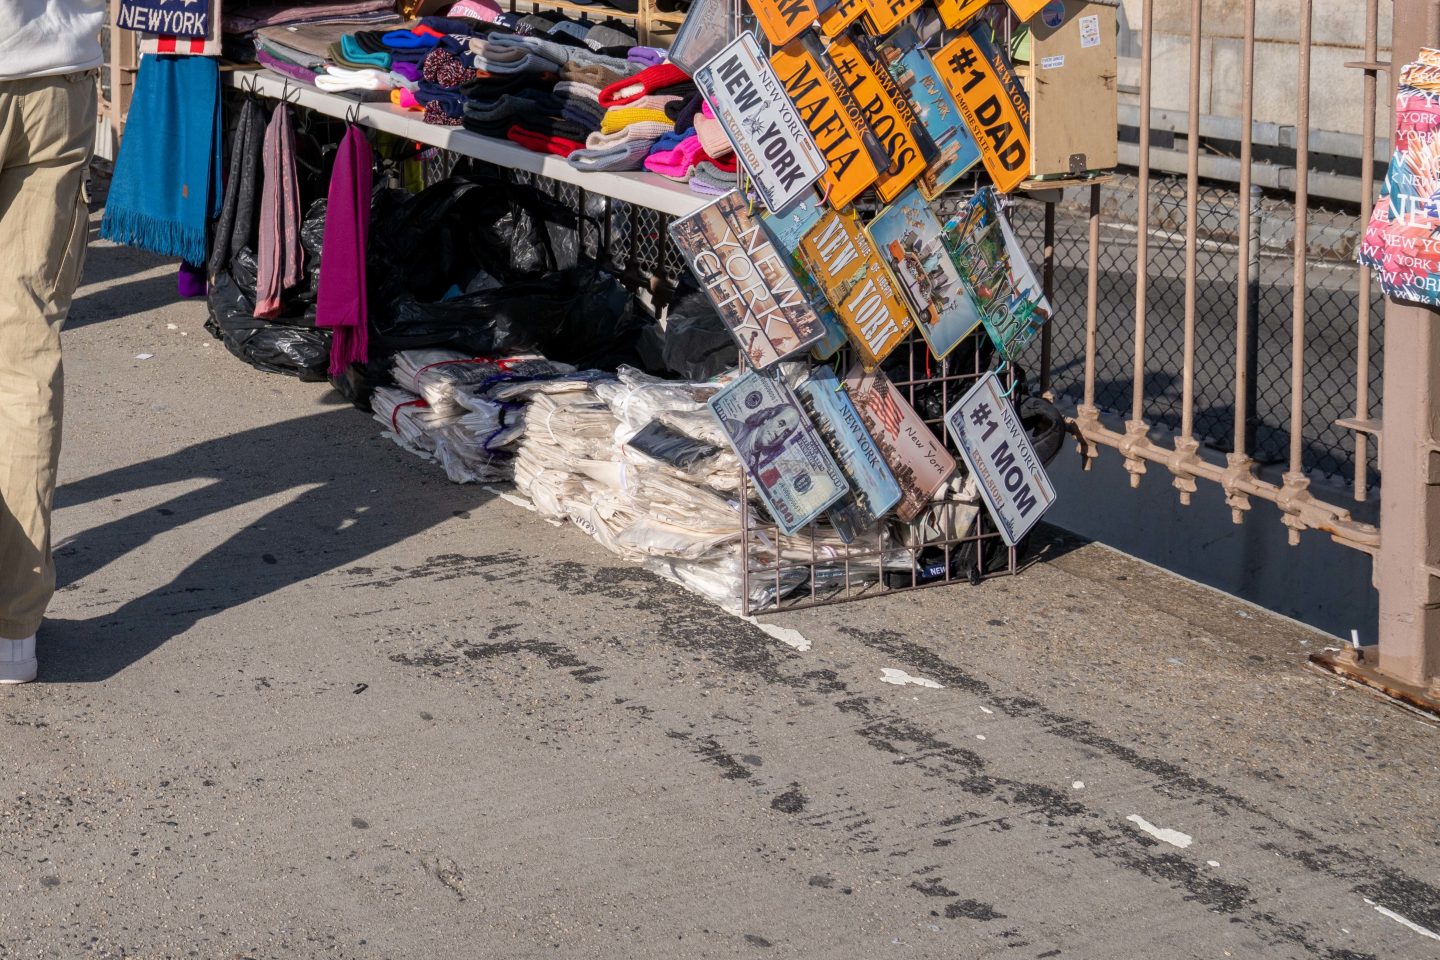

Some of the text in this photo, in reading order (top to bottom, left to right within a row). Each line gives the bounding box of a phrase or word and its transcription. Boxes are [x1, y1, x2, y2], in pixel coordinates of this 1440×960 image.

[758, 71, 805, 144] NEW YORK
[824, 64, 872, 139] NEW YORK
[838, 57, 867, 91] #1
[871, 59, 917, 128] NEW YORK
[919, 74, 938, 97] NEW
[992, 55, 1031, 124] NEW YORK
[716, 53, 806, 193] NEW YORK
[722, 109, 760, 171] EXCELSIOR
[780, 60, 860, 182] MAFIA
[947, 47, 1027, 172] #1 DAD
[955, 93, 991, 154] EMPIRE STATE
[1402, 112, 1438, 124] YORK
[693, 250, 762, 332] CITY
[712, 226, 789, 333] YORK
[736, 224, 807, 308] NEW
[812, 214, 899, 355] NEW YORK
[1397, 255, 1432, 269] YORK
[1403, 272, 1440, 292] YOR
[840, 405, 880, 468] NEW YORK
[905, 427, 945, 475] New York
[970, 402, 1038, 519] #1 MOM
[1001, 408, 1037, 475] NEW YORK
[971, 449, 1003, 506] EXCELSIOR
